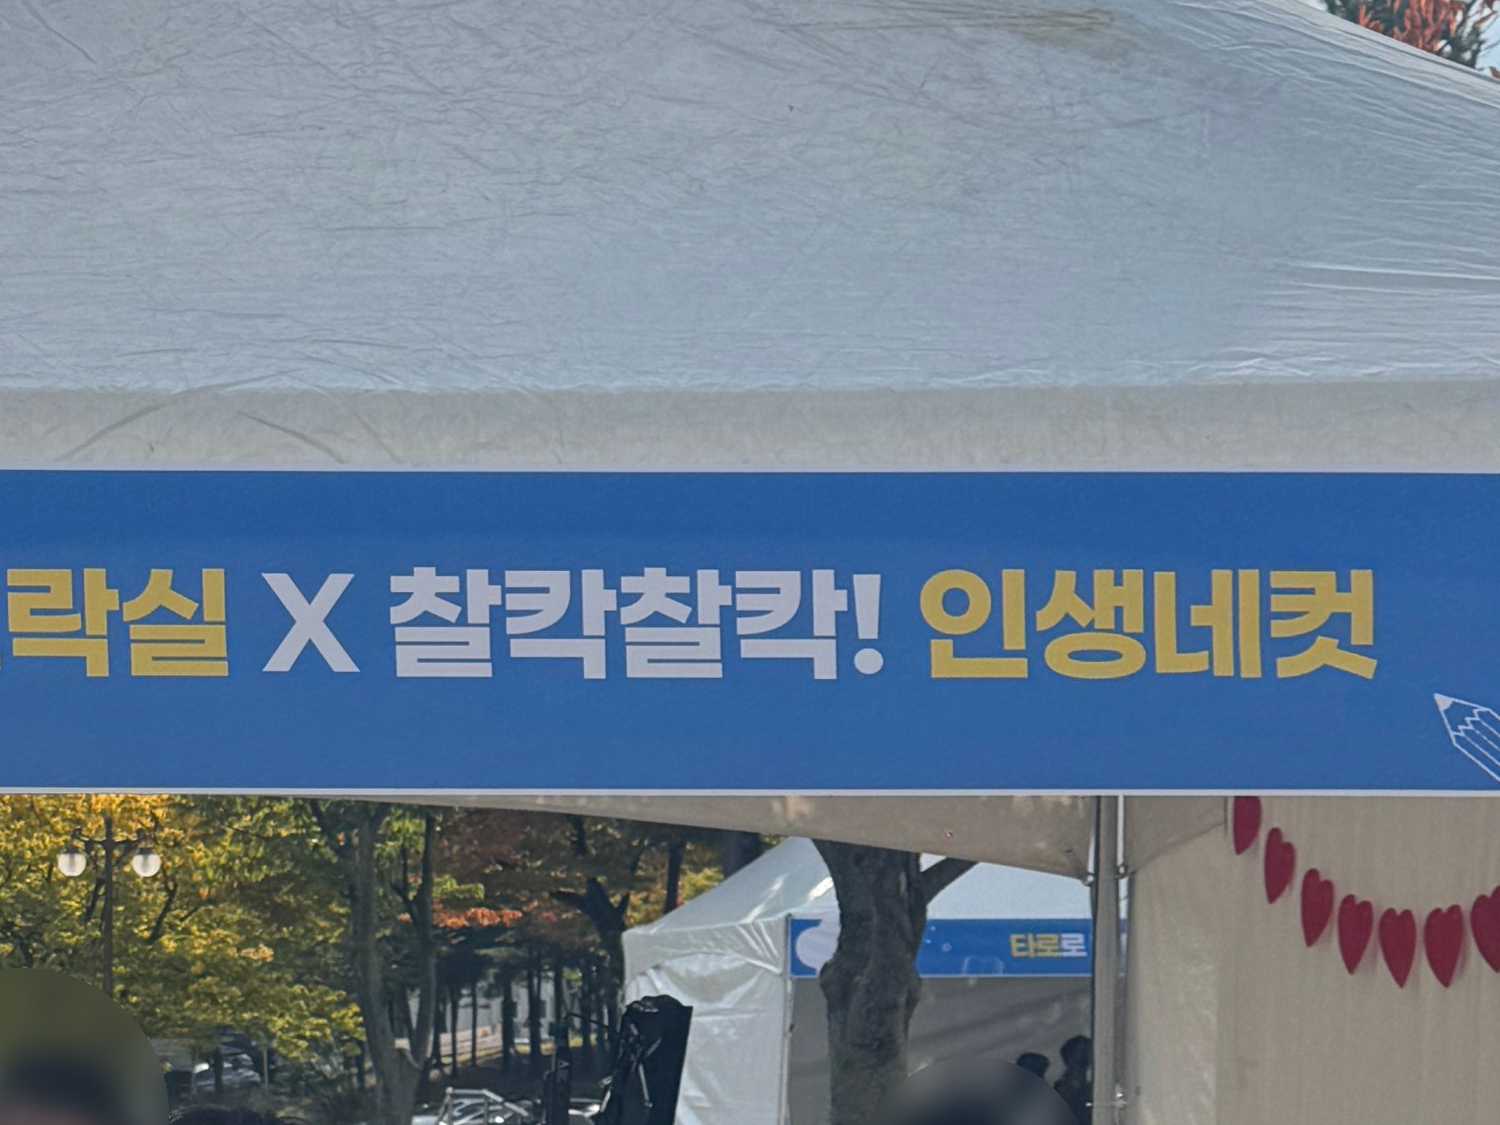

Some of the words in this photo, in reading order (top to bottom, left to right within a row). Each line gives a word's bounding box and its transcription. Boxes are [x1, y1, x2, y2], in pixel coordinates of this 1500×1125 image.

[261, 573, 361, 673] X
[389, 566, 885, 680] 찰칵찰칵!
[919, 568, 1378, 680] 인생네컷
